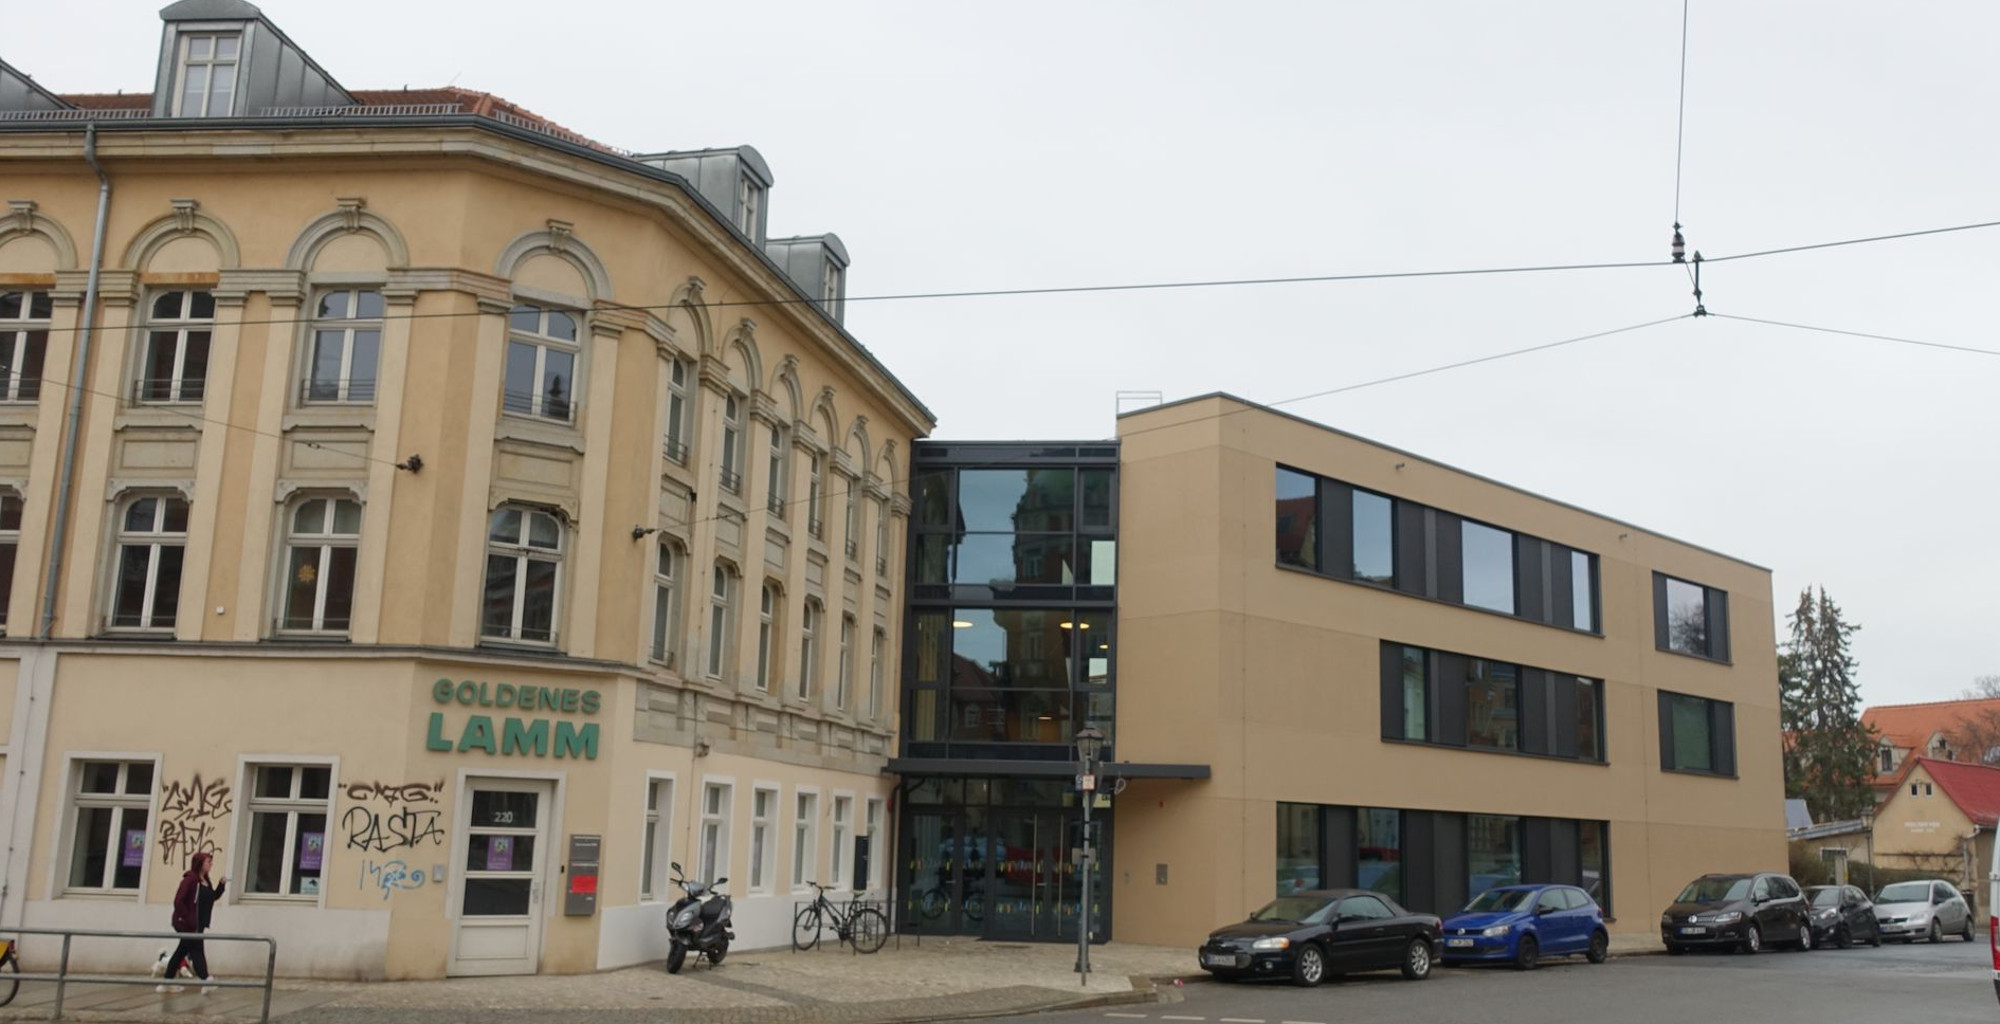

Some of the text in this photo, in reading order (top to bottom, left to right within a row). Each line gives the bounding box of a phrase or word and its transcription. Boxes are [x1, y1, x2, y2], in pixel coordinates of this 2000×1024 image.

[432, 678, 601, 714] GOLDENES
[426, 712, 600, 760] LAMM
[342, 806, 446, 853] RASTA
[494, 811, 514, 823] 220
